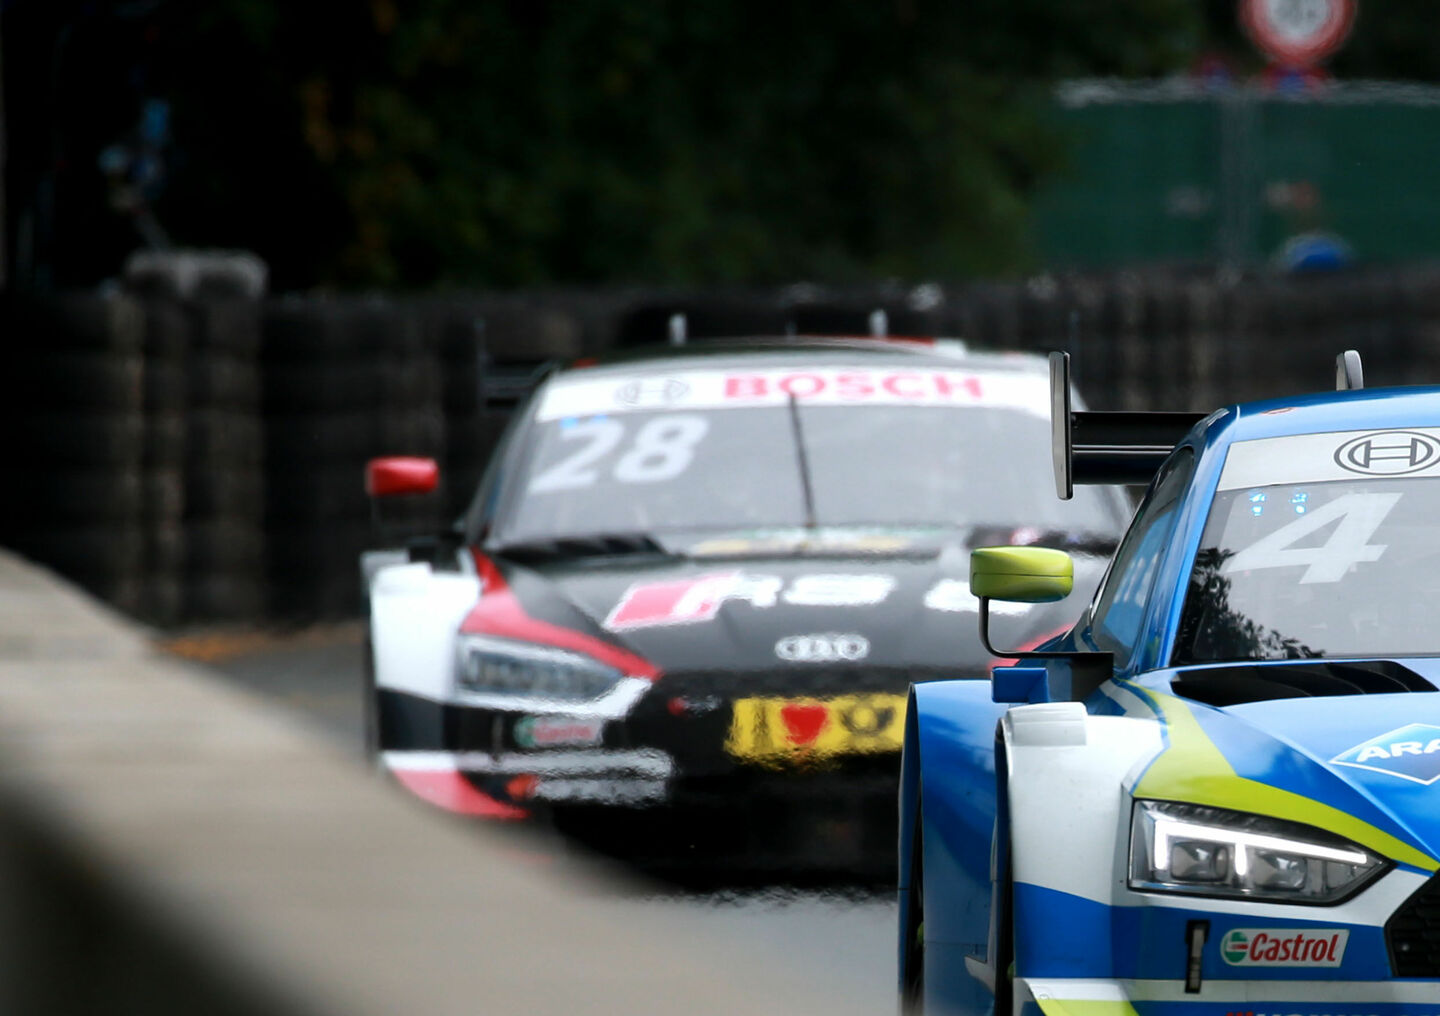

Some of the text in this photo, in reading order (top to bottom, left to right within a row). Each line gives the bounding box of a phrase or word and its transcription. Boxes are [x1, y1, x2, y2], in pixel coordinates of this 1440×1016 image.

[723, 372, 985, 401] BOSCH
[526, 414, 710, 494] 28
[1226, 492, 1403, 585] 4
[1249, 932, 1339, 963] Castrol
